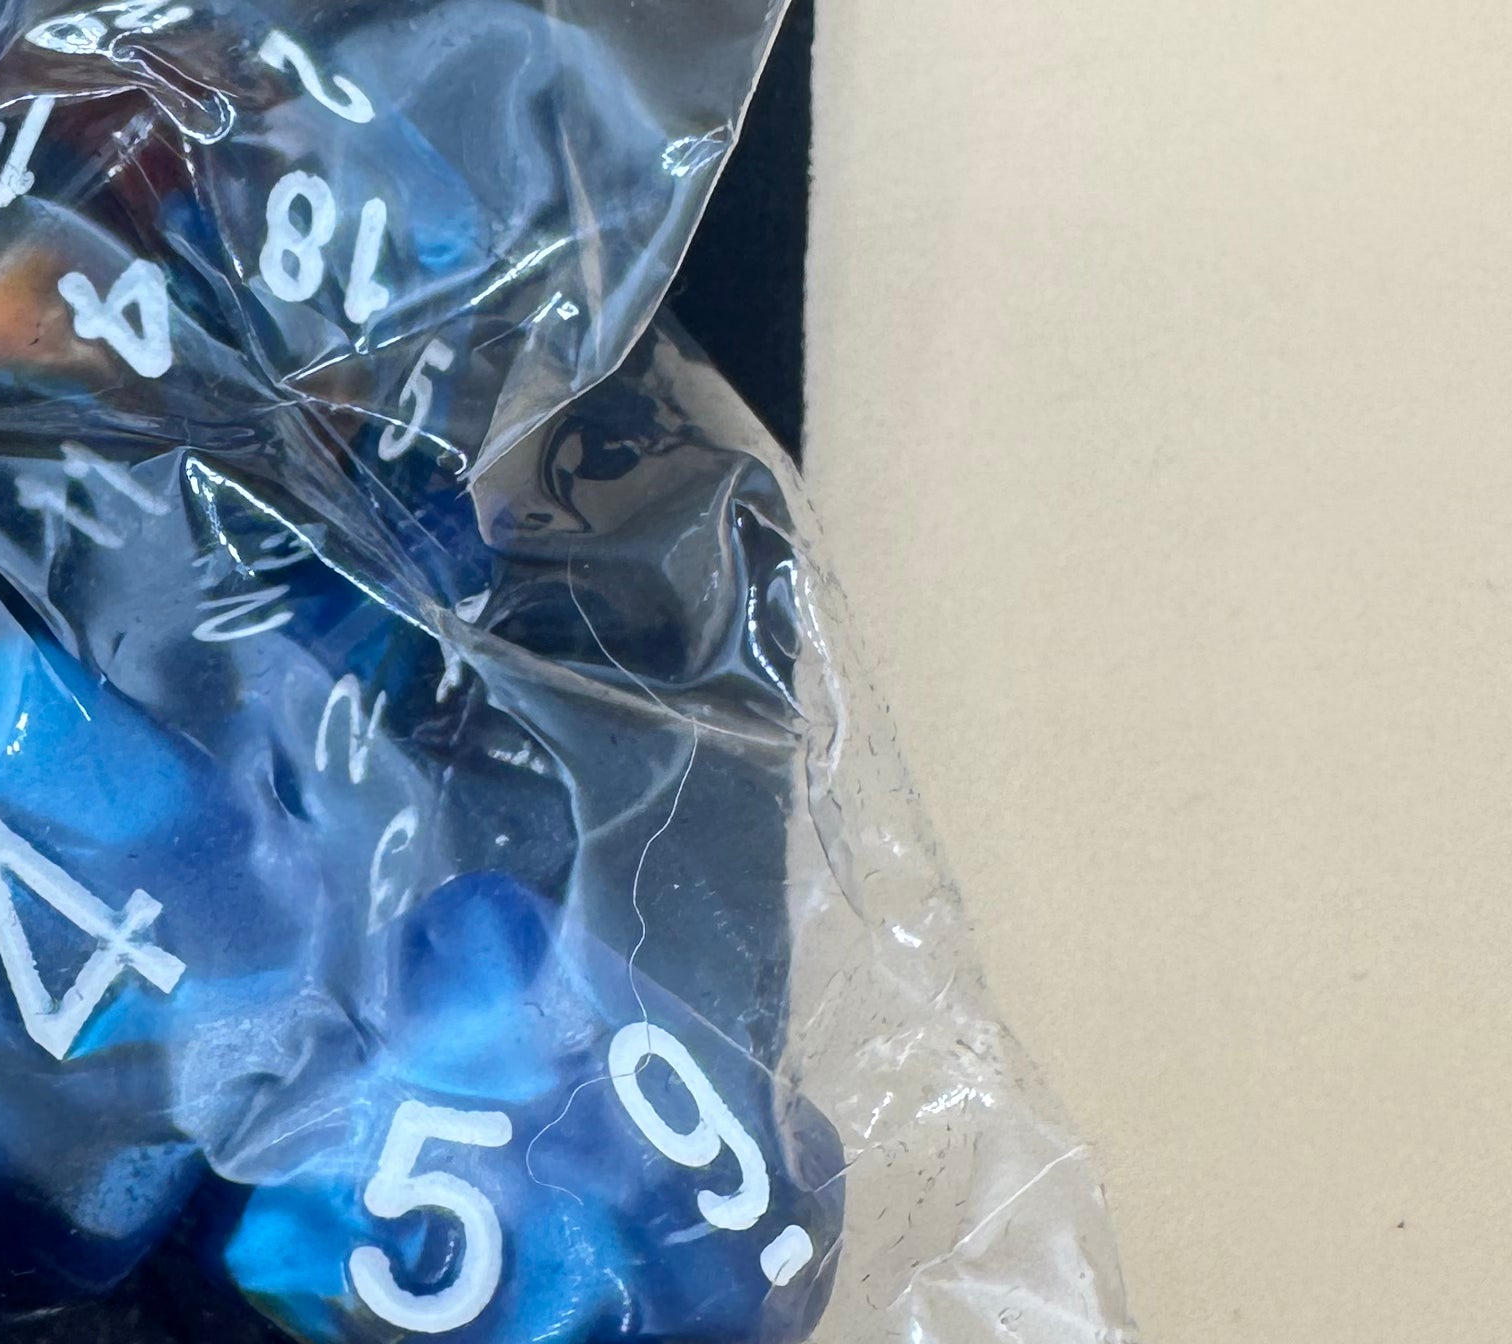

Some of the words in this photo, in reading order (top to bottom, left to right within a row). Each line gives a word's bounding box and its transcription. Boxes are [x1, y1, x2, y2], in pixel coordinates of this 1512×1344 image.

[57, 258, 172, 379] 4
[258, 169, 389, 324] 18
[347, 1099, 513, 1334] 5
